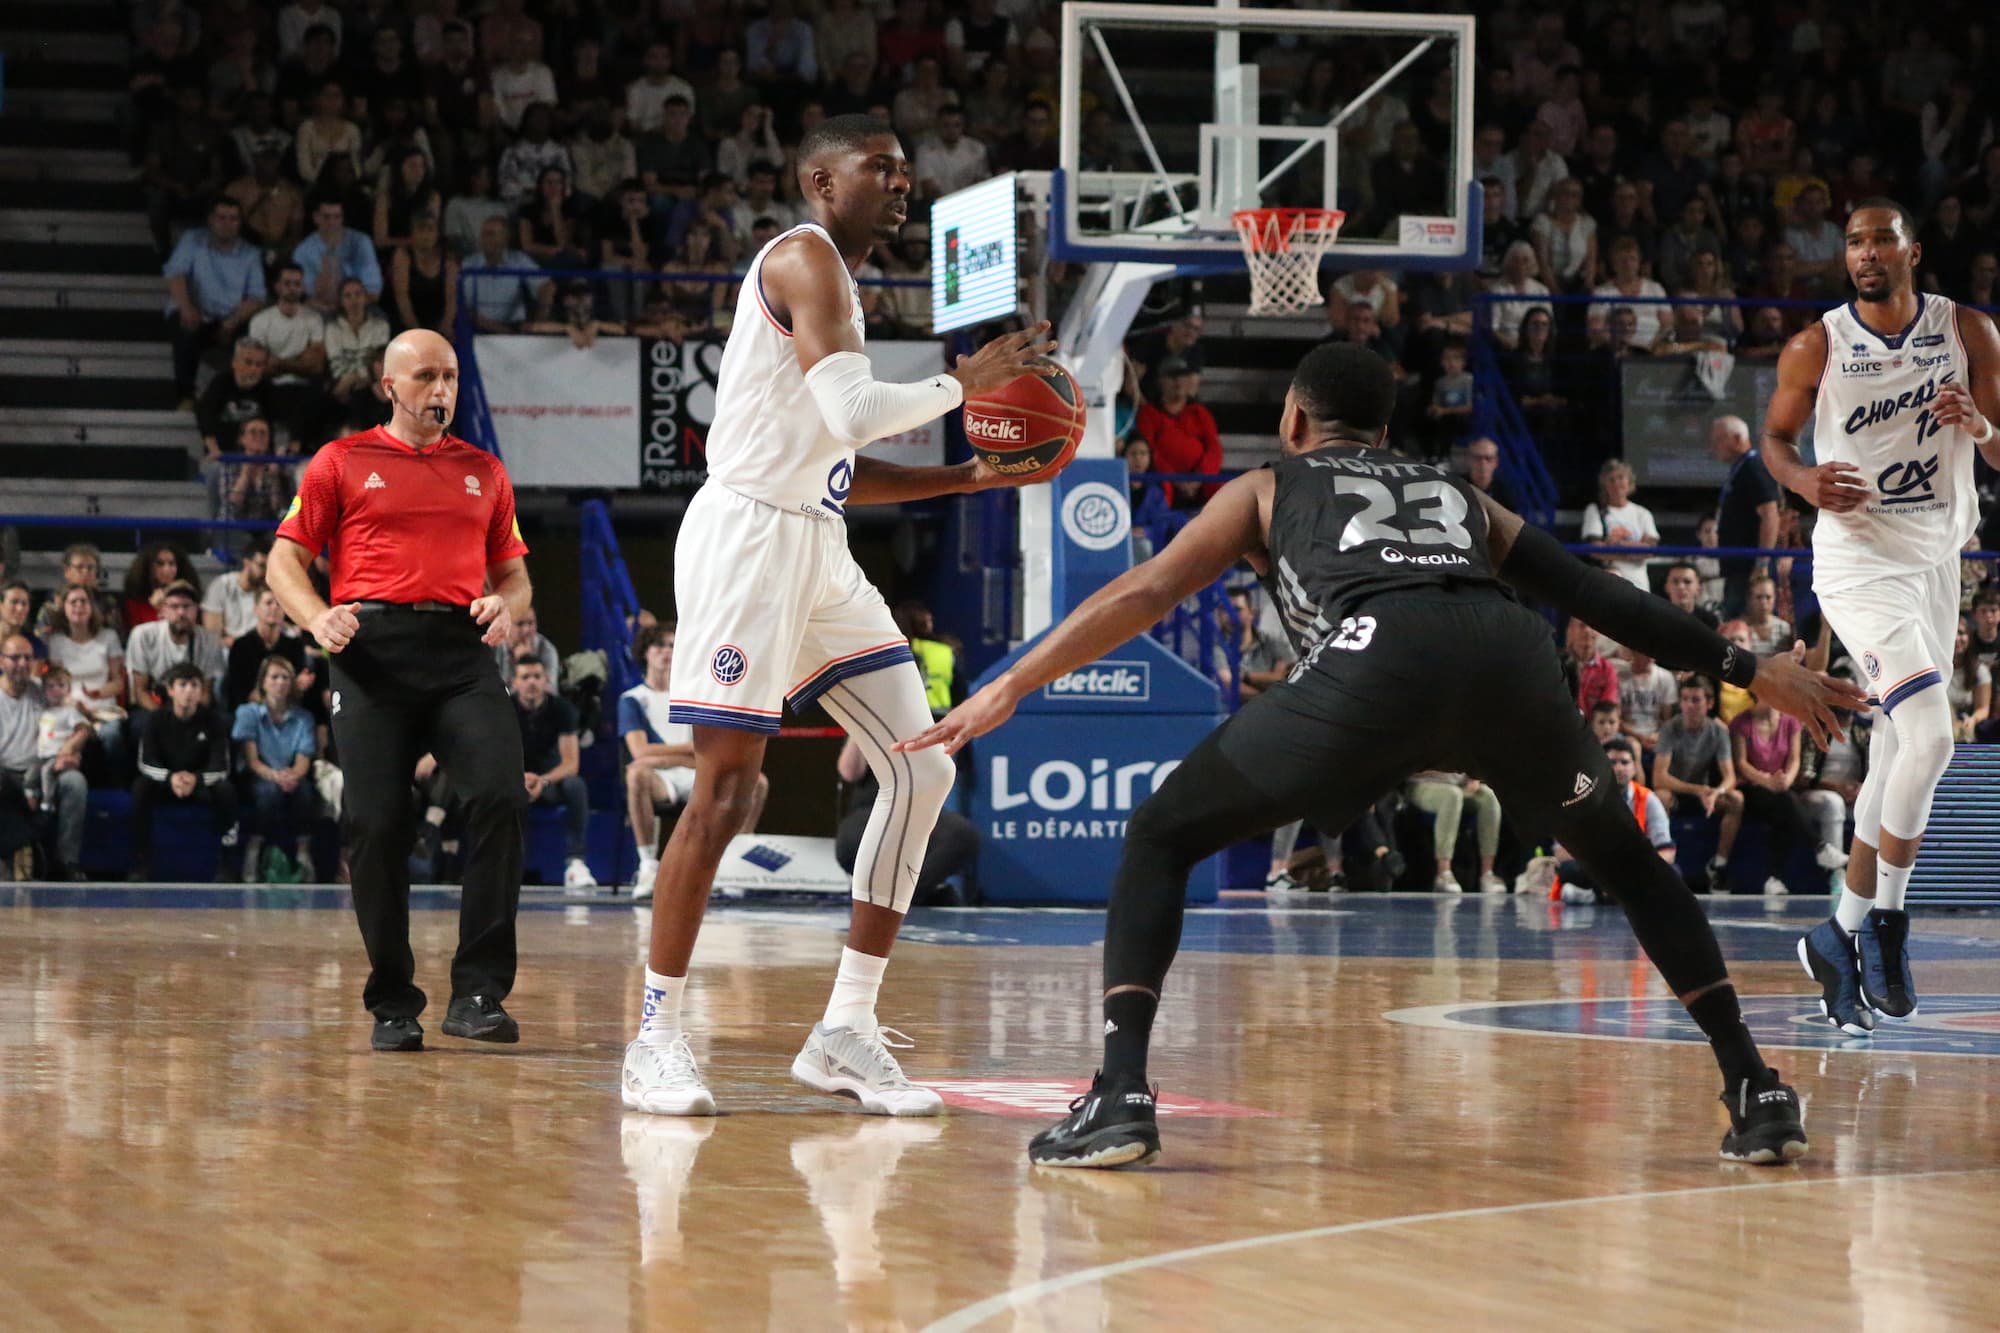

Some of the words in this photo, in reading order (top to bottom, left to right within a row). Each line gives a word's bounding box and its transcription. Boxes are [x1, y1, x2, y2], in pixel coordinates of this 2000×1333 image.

[1842, 361, 1883, 373] Loire
[644, 340, 683, 466] Rouge
[966, 414, 1022, 440] Betclic
[1334, 475, 1472, 552] 23
[1404, 553, 1471, 566] VEOLIA
[1330, 616, 1377, 651] 23
[1053, 668, 1141, 694] Betclic
[992, 821, 1017, 838] LE
